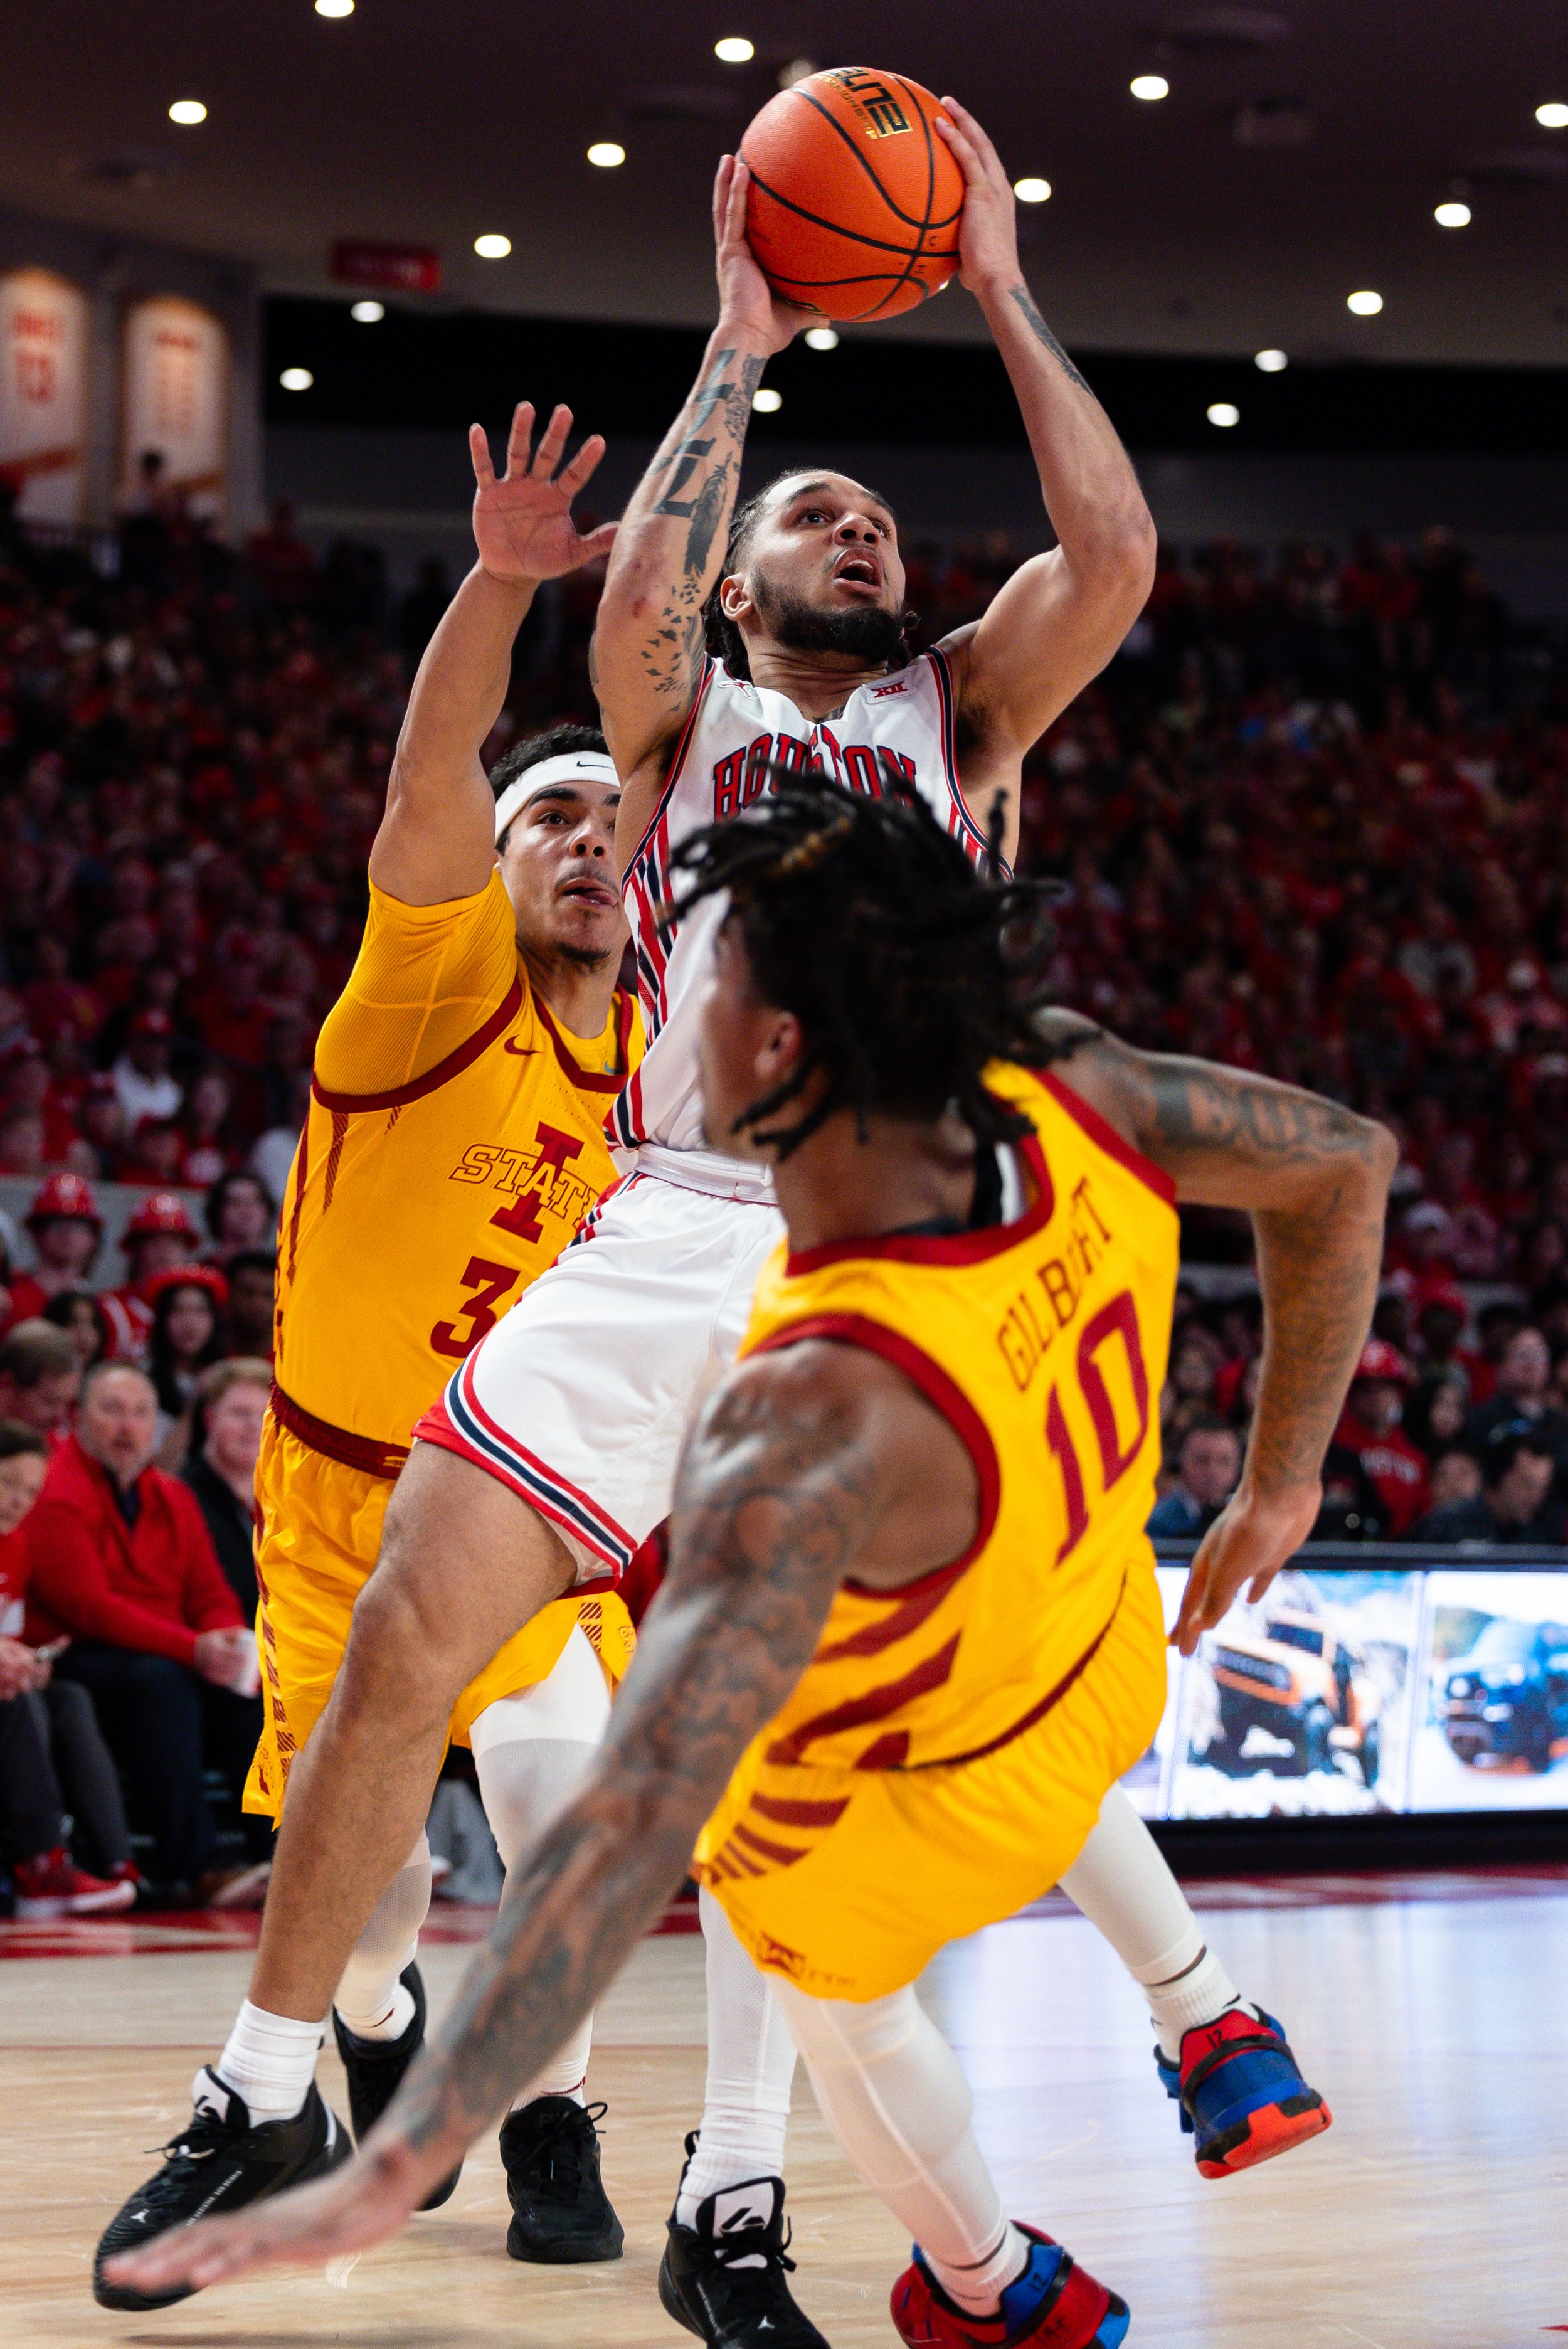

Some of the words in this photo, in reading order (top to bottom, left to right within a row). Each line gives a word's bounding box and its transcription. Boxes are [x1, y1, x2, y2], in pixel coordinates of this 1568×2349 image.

[871, 681, 908, 698] XII
[430, 1256, 521, 1359] 3
[1046, 1289, 1150, 1568] 10
